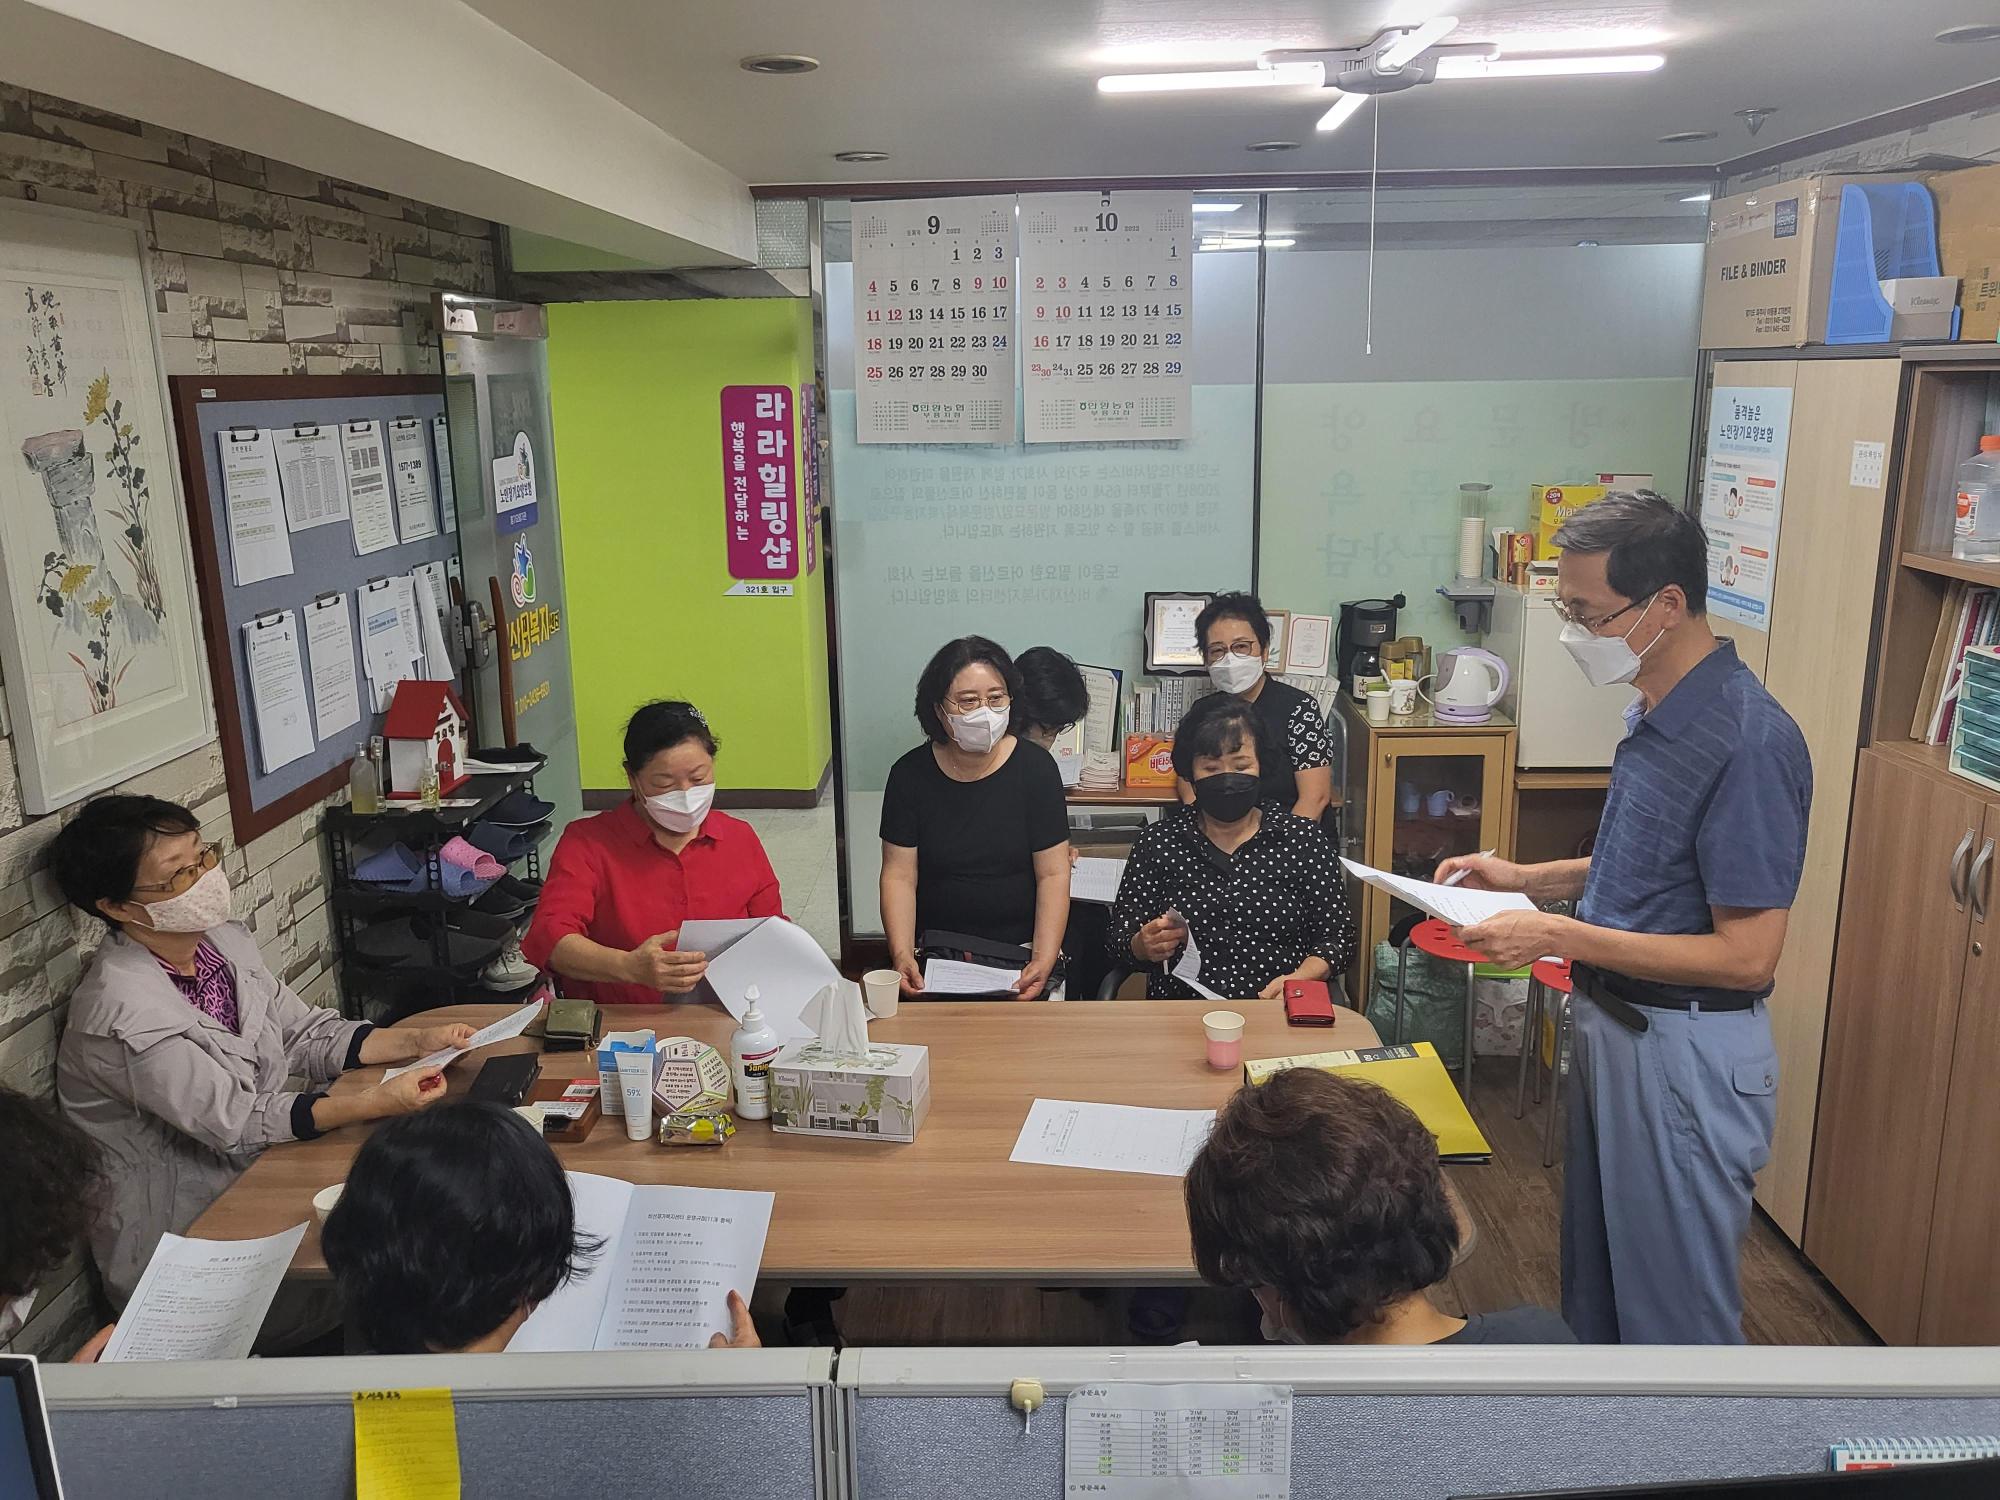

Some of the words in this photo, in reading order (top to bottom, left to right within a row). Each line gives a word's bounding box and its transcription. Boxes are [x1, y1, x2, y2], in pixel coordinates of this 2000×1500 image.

[928, 216, 940, 234] 9
[1096, 212, 1118, 232] 10
[952, 248, 960, 260] 1
[974, 248, 982, 260] 2
[994, 246, 1002, 258] 3
[1170, 246, 1178, 258] 1
[1721, 265, 1738, 281] FILE
[1741, 264, 1748, 278] &
[1750, 258, 1787, 278] BINDER
[868, 280, 876, 294] 4
[890, 280, 898, 292] 5
[910, 280, 918, 292] 6
[932, 278, 940, 290] 7
[952, 278, 960, 290] 8
[974, 278, 982, 290] 9
[992, 276, 1006, 290] 10
[1036, 276, 1044, 288] 2
[1058, 276, 1066, 288] 3
[1080, 276, 1088, 288] 4
[1102, 276, 1110, 288] 5
[1124, 276, 1132, 288] 6
[1148, 276, 1156, 288] 7
[1170, 274, 1178, 286] 8
[866, 310, 880, 322] 11
[886, 308, 902, 322] 12
[908, 308, 922, 320] 13
[930, 308, 944, 320] 14
[950, 308, 966, 320] 15
[972, 306, 986, 320] 16
[992, 306, 1008, 318] 17
[1036, 306, 1044, 318] 9
[1056, 306, 1070, 318] 10
[1078, 306, 1092, 318] 11
[1100, 304, 1116, 318] 12
[1122, 304, 1136, 316] 13
[1144, 304, 1160, 316] 14
[1166, 304, 1182, 316] 15
[868, 338, 882, 350] 18
[888, 338, 902, 350] 19
[908, 338, 924, 350] 20
[928, 336, 944, 348] 21
[950, 336, 966, 348] 22
[972, 336, 986, 348] 23
[992, 336, 1006, 348] 24
[1034, 336, 1048, 348] 16
[1056, 336, 1072, 348] 17
[1078, 334, 1094, 346] 18
[1100, 334, 1114, 346] 19
[1120, 334, 1138, 346] 20
[1142, 334, 1158, 346] 21
[1166, 332, 1182, 346] 22
[866, 366, 882, 380] 25
[888, 366, 904, 378] 26
[910, 366, 924, 378] 27
[930, 366, 946, 378] 28
[950, 366, 966, 378] 29
[972, 364, 988, 376] 30
[1078, 364, 1094, 376] 25
[1098, 362, 1116, 376] 26
[1120, 362, 1138, 374] 27
[1142, 362, 1160, 374] 28
[1166, 362, 1182, 374] 29
[1734, 404, 1761, 421] 품격높은
[1720, 424, 1774, 443] 노인장기요양보험
[730, 421, 745, 471] 행복을
[756, 392, 791, 570] 라라힐링샵
[733, 476, 749, 541] 전달하는
[746, 586, 768, 594] 321호
[772, 585, 788, 594] 입구
